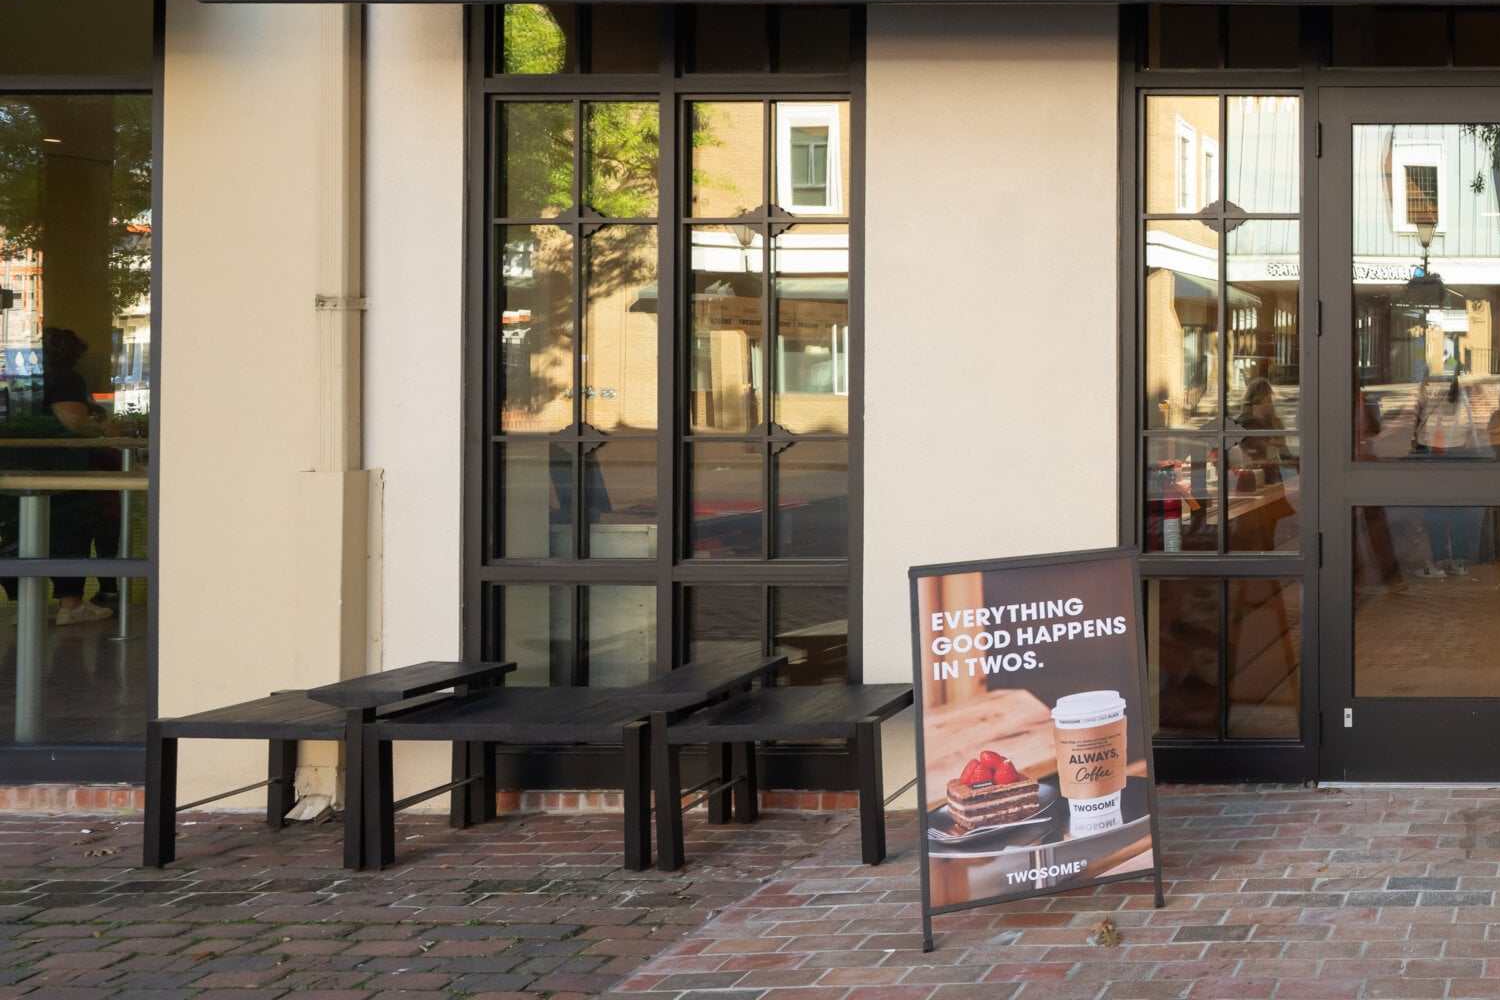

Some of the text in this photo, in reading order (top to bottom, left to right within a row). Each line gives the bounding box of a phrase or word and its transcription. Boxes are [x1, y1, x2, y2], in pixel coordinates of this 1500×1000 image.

[931, 597, 1084, 632] EVERYTHING
[931, 616, 1127, 656] GOOD HAPPENS
[933, 651, 1044, 680] IN TWOS.
[1068, 748, 1118, 765] ALWAYS,
[1075, 766, 1114, 782] Coffee
[1074, 799, 1116, 812] TWOSOME
